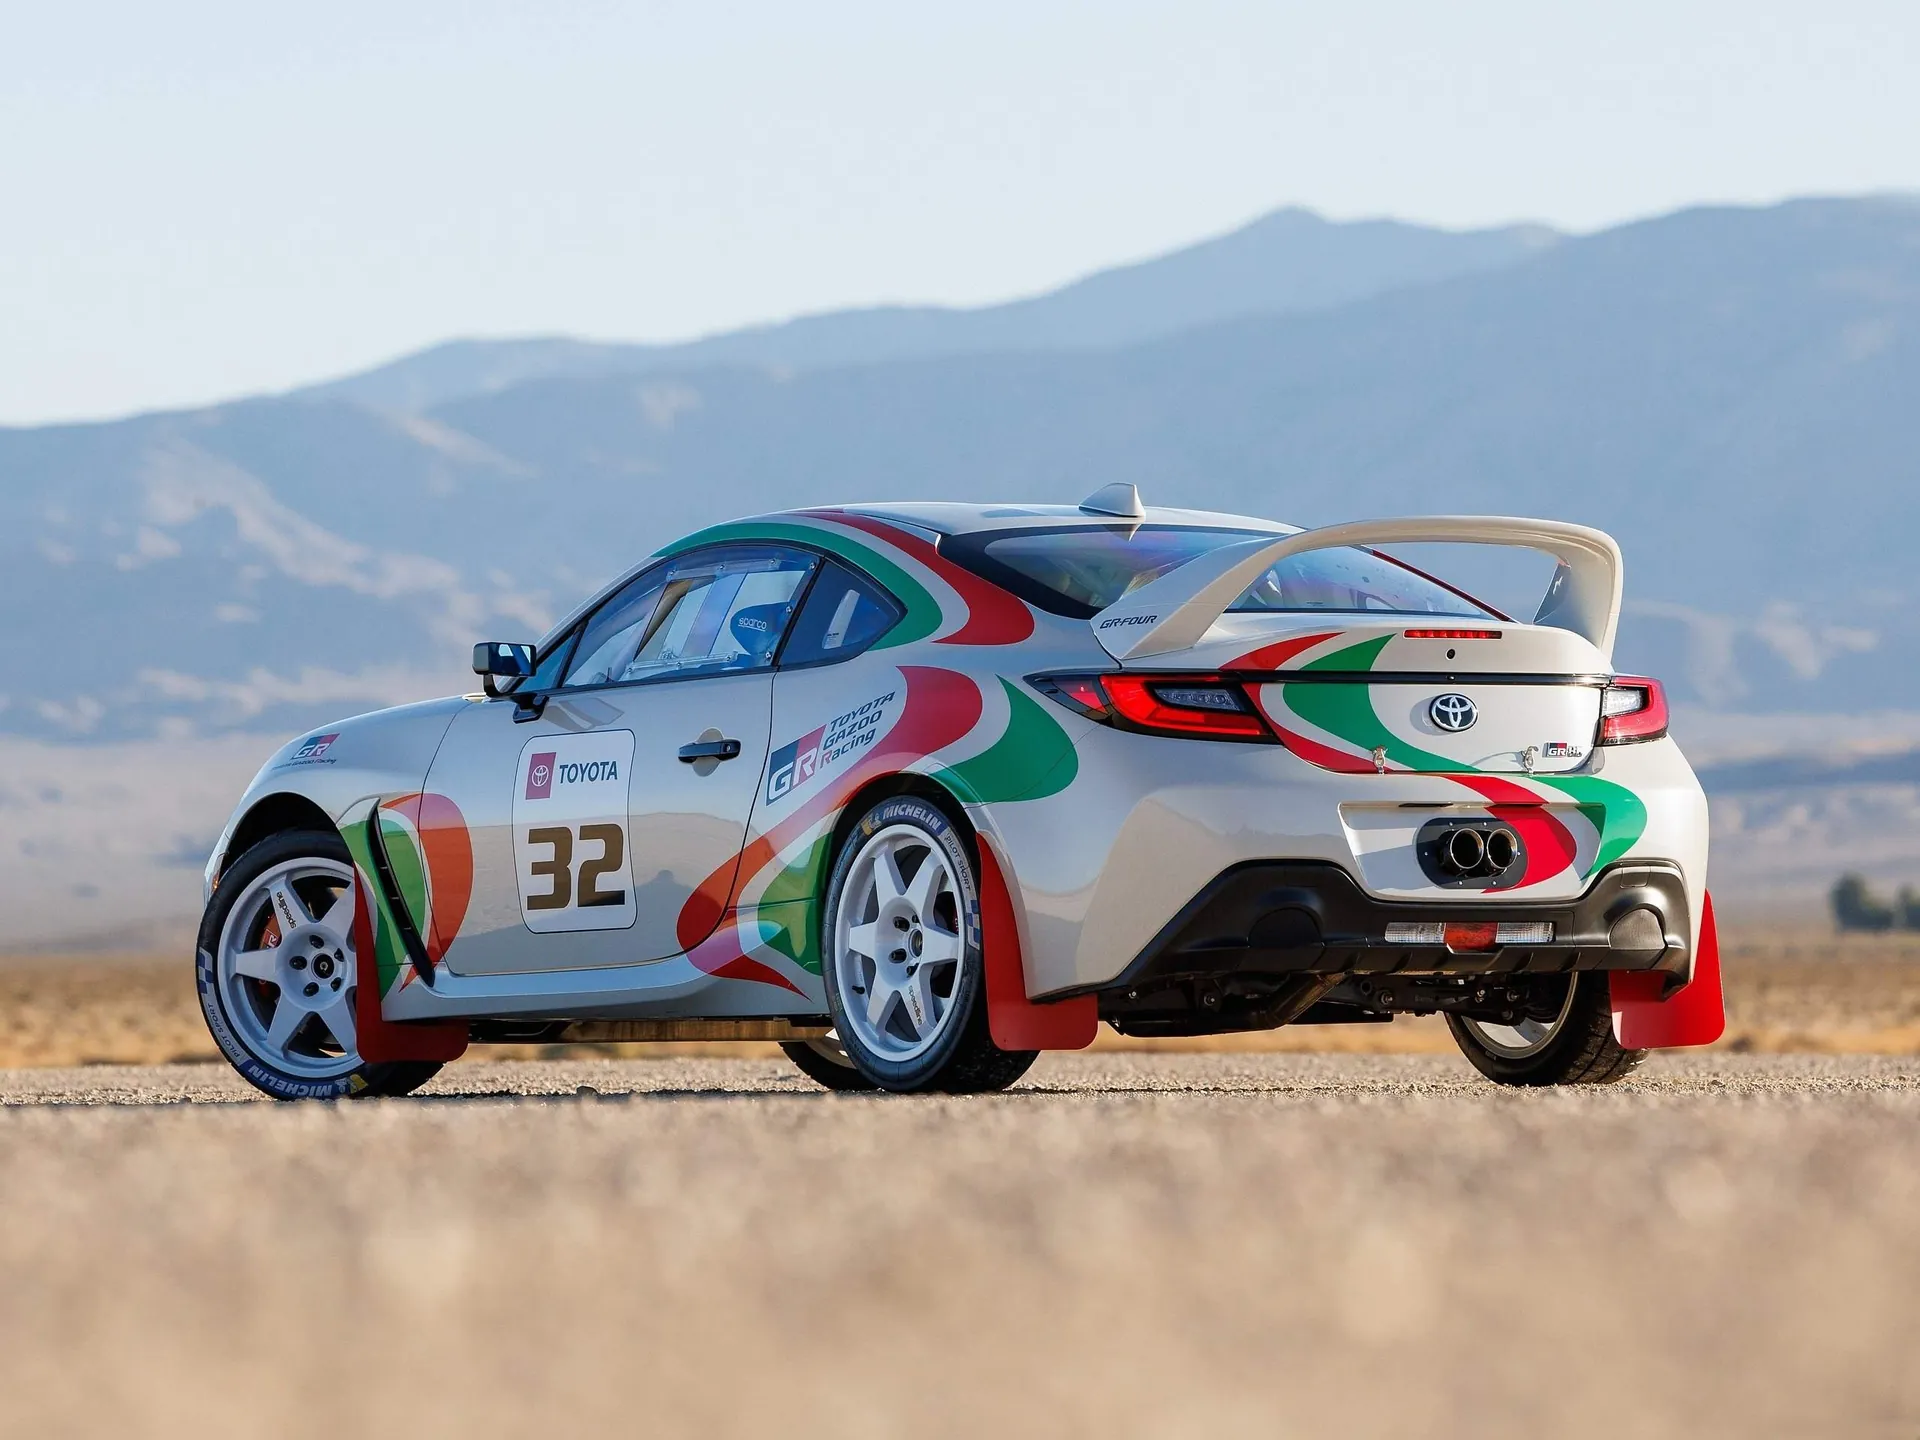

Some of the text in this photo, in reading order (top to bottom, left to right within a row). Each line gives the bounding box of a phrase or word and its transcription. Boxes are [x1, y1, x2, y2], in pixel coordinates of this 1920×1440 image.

[739, 617, 767, 630] sparco
[1100, 615, 1158, 629] GR-FOUR
[823, 709, 883, 751] GAZOO
[830, 691, 895, 733] TOYOTA
[293, 743, 330, 759] GR
[820, 728, 876, 769] Racing
[559, 760, 618, 784] TOYOTA
[768, 747, 818, 801] GR
[527, 823, 626, 911] 32
[882, 804, 971, 891] MICHELIN PILOT SPORT
[276, 891, 297, 929] speedline
[908, 984, 923, 1026] speedline
[207, 1002, 332, 1097] MICHELIN PILOT SPORT
